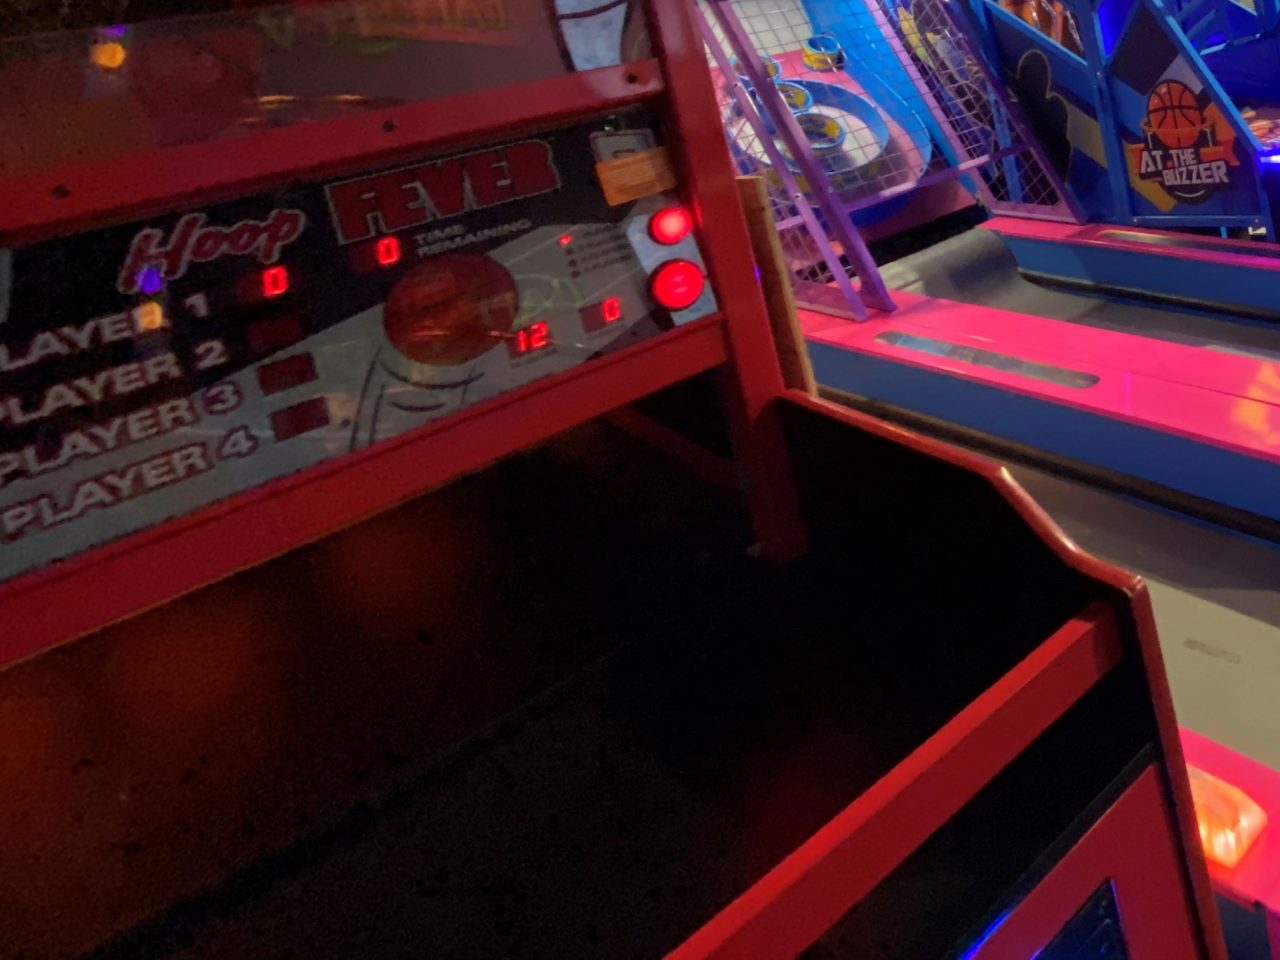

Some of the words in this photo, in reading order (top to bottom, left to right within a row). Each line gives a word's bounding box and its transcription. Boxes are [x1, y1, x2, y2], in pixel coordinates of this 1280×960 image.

[1140, 149, 1164, 175] AT
[1169, 148, 1196, 167] THE
[1162, 160, 1230, 187] BUZZER
[116, 209, 306, 294] Hoop
[323, 139, 563, 245] FEVER
[376, 237, 400, 265] 0
[263, 266, 288, 297] 0
[185, 292, 209, 317] 1
[517, 320, 549, 352] 12
[0, 352, 183, 425] LAYER
[194, 341, 229, 369] 2
[205, 382, 240, 411] 3
[2, 445, 208, 534] PLAYER
[221, 426, 254, 457] 4
